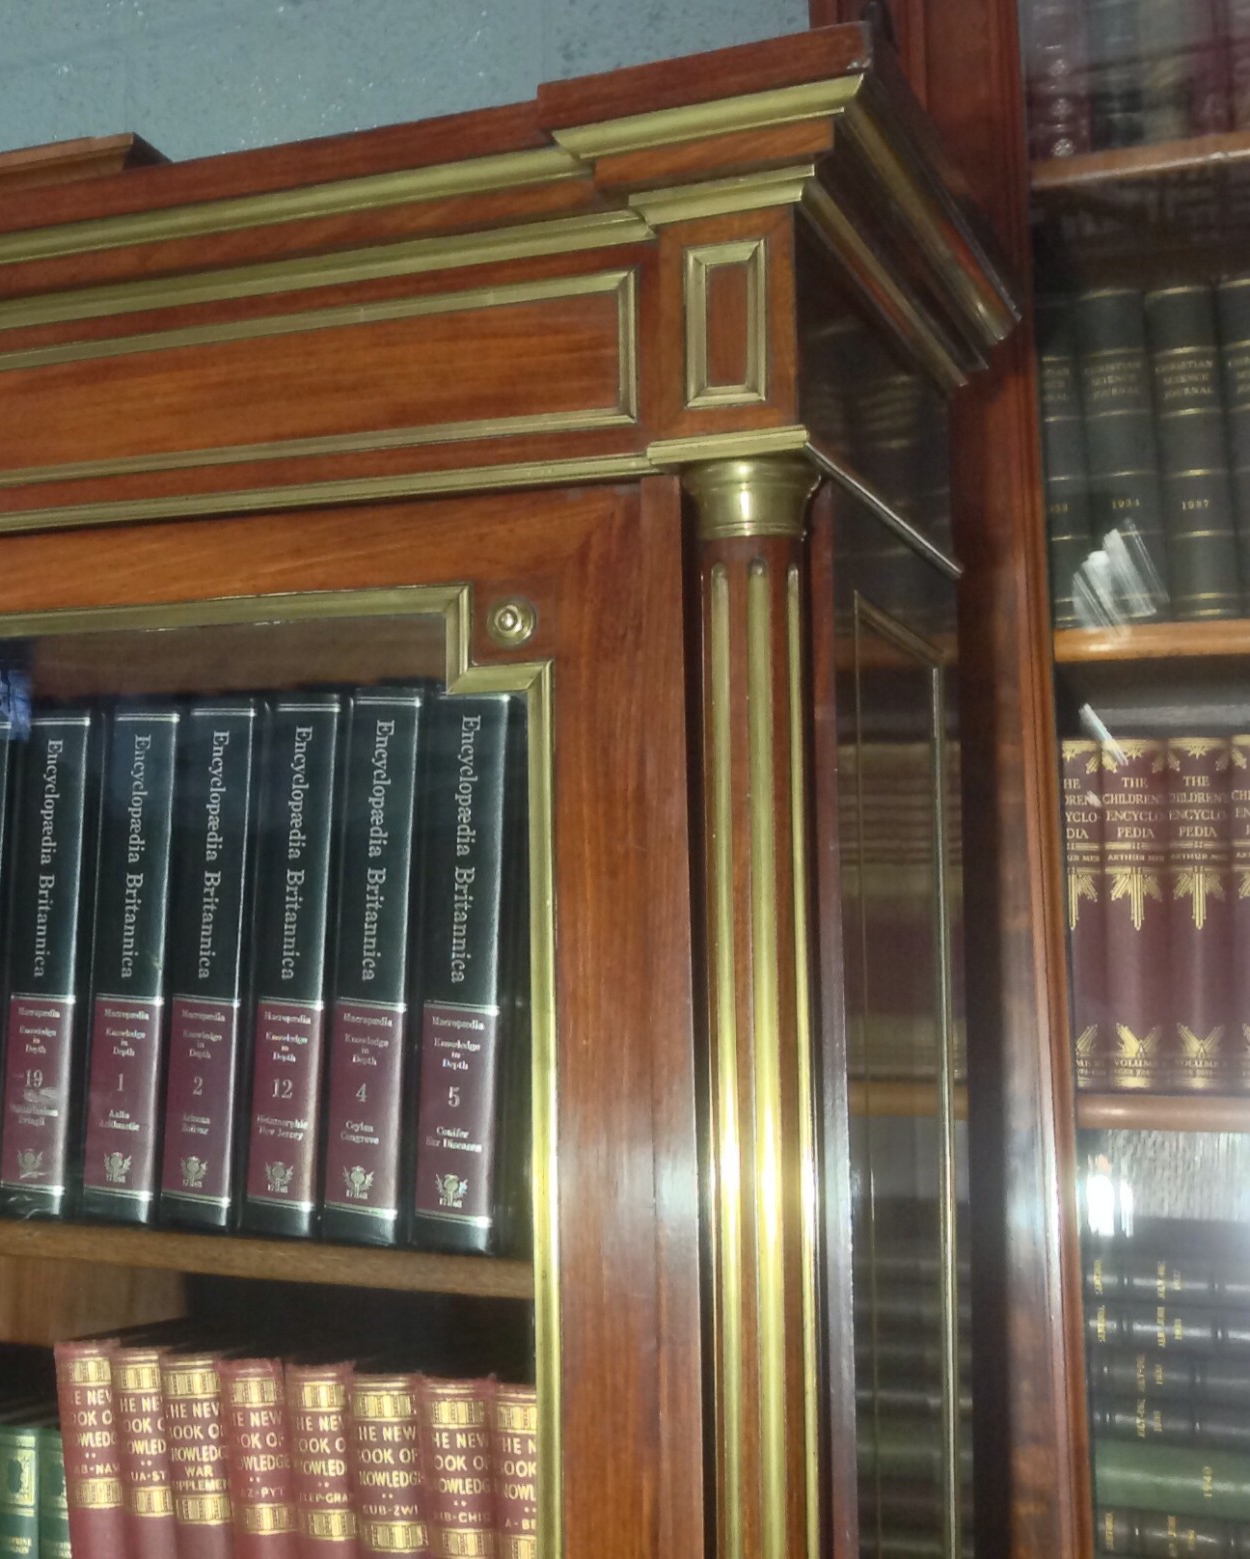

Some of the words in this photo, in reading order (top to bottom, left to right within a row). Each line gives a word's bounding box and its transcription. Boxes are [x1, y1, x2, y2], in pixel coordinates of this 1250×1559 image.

[368, 719, 395, 858] Encyclopædia
[454, 715, 481, 857] Encyclopædia
[1121, 777, 1149, 789] THE
[1182, 775, 1210, 787] THE
[40, 739, 64, 866] Encyclopædia
[127, 734, 151, 864] Encyclopædia
[206, 730, 230, 862] Encyclopædia
[288, 726, 313, 860] Encyclopædia
[1117, 827, 1155, 839] PEDIA
[1179, 825, 1218, 838] PEDIA
[33, 874, 56, 978] Britannica
[121, 872, 144, 979] Britannica
[198, 870, 222, 979] Britannica
[281, 869, 305, 980] Britannica
[362, 867, 387, 981] Britannica
[450, 866, 475, 983] Britannica
[352, 1054, 377, 1067] Depth
[442, 1058, 469, 1071] Depth
[24, 1069, 43, 1089] 19
[116, 1073, 125, 1092] 1
[192, 1076, 204, 1096] 2
[271, 1078, 293, 1099] 12
[355, 1083, 368, 1103] 4
[447, 1086, 461, 1108] 5
[142, 1396, 163, 1413] NE
[250, 1409, 282, 1428] NEW
[382, 1424, 417, 1443] NEW
[357, 1447, 395, 1465] OOK
[184, 1464, 214, 1477] WAR
